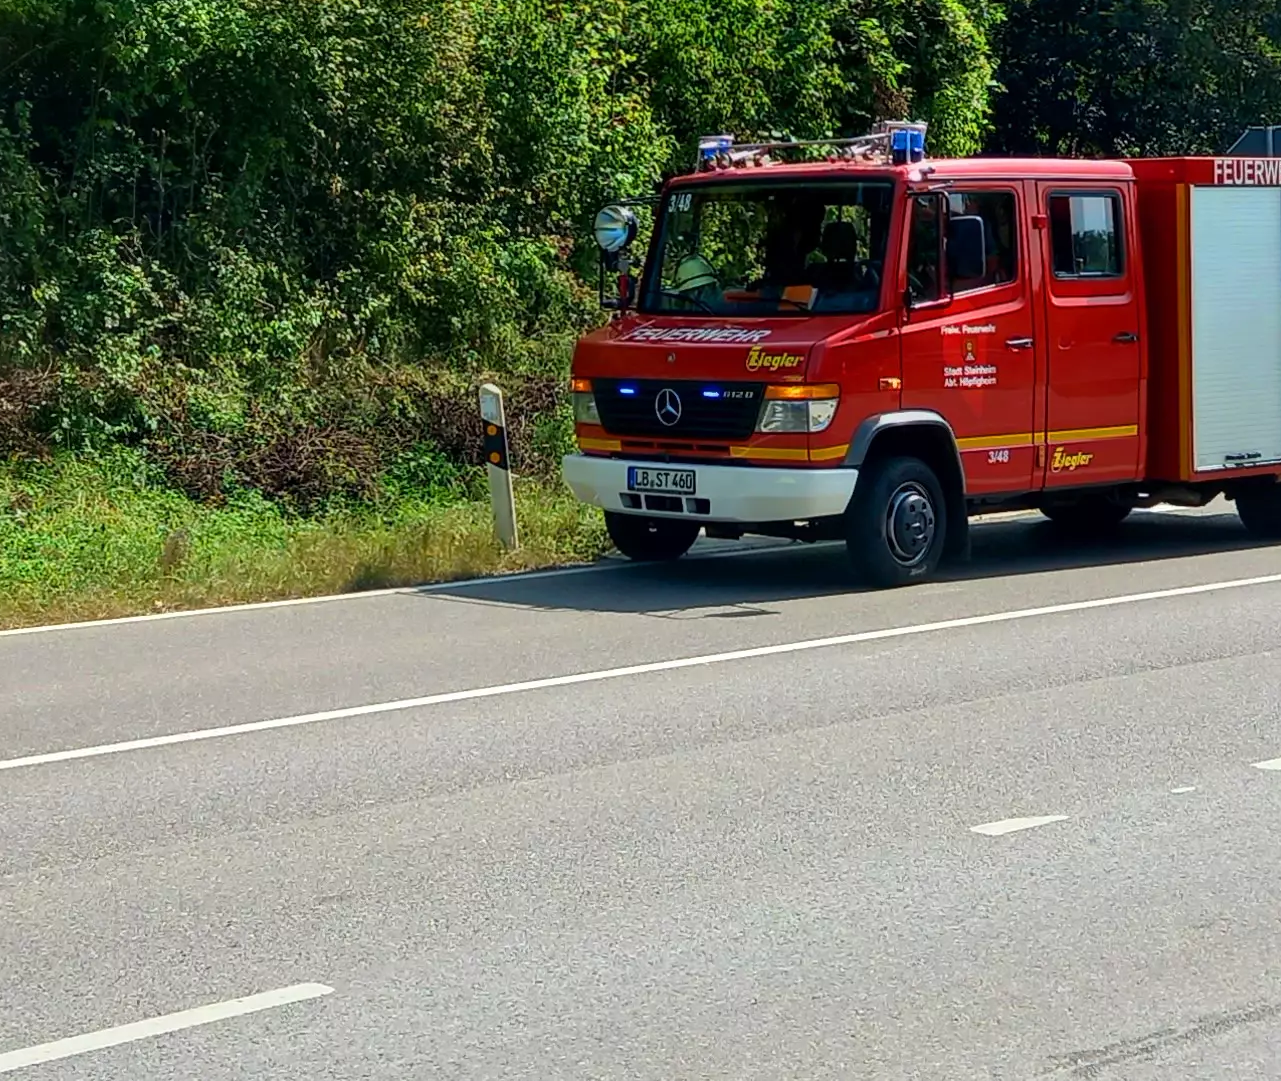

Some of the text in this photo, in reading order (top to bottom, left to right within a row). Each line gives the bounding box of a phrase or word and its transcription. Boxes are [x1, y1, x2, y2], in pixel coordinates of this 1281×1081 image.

[668, 193, 692, 212] 3/48
[622, 328, 772, 342] FEUERWEHR
[746, 344, 804, 372] Ziegler
[964, 365, 996, 375] Steinheim
[988, 450, 1009, 463] 3/48
[1051, 446, 1093, 473] Ziegler
[635, 471, 692, 489] LB ST 460
